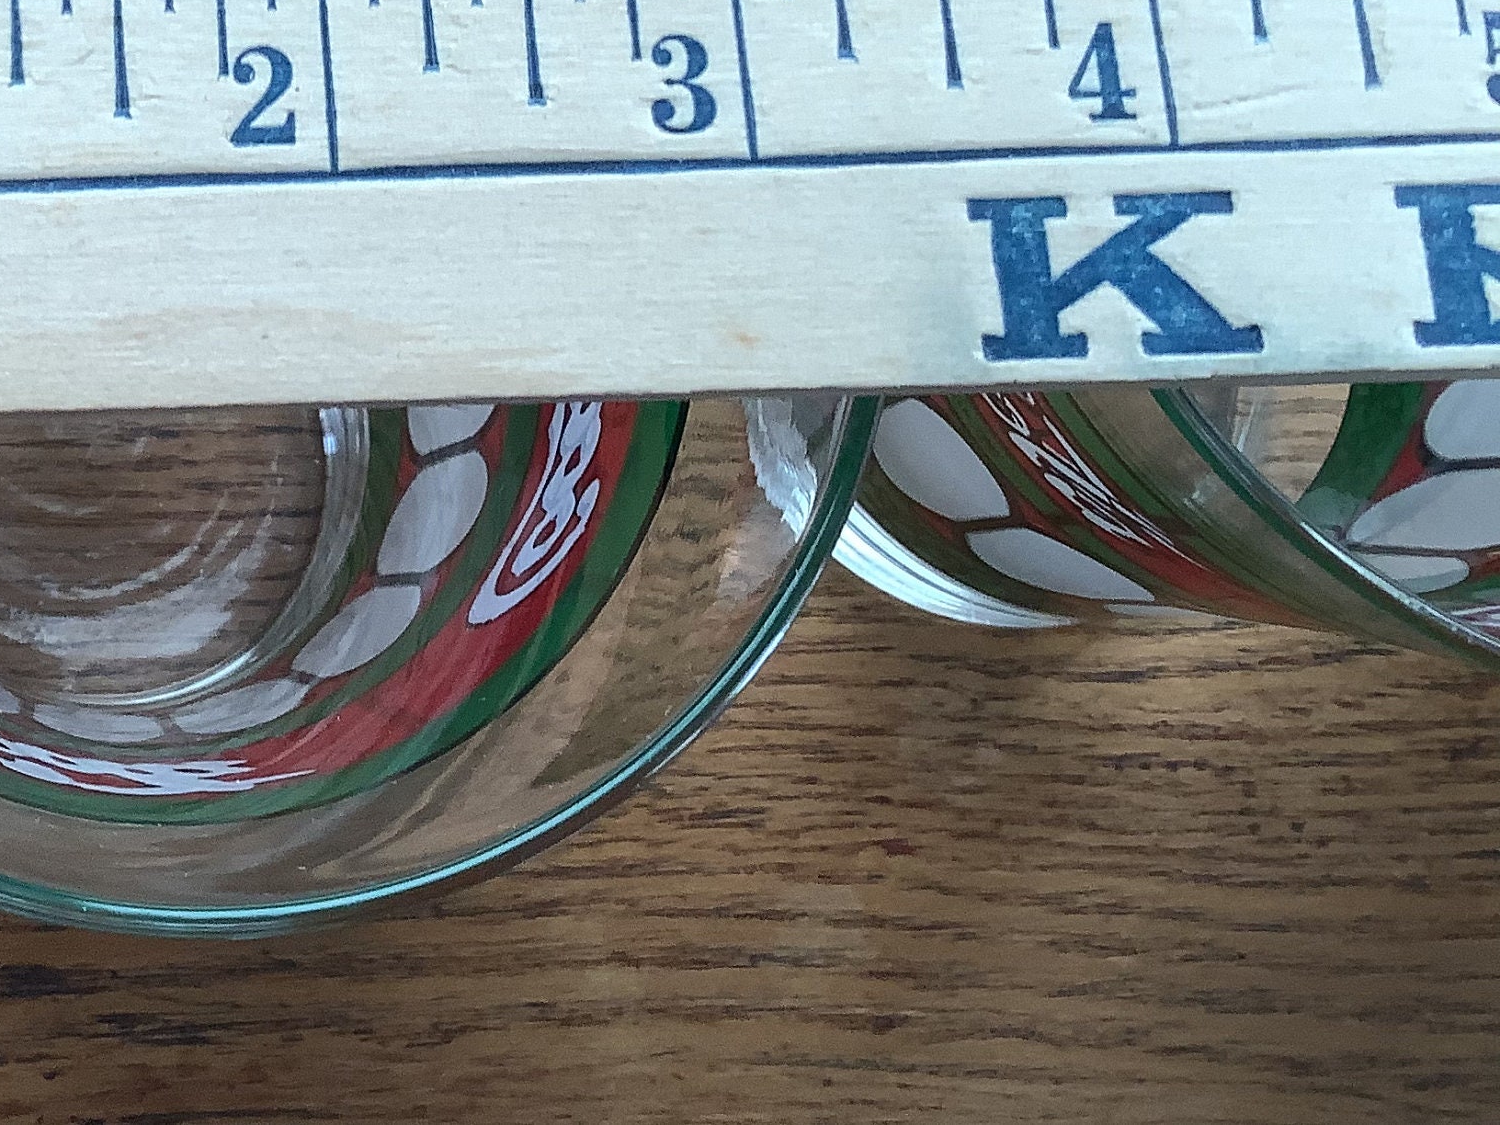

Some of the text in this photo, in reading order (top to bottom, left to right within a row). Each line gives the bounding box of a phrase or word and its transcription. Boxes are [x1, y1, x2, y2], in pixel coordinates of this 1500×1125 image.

[229, 45, 297, 148] 2
[651, 33, 718, 135] 3
[1067, 22, 1138, 122] 4
